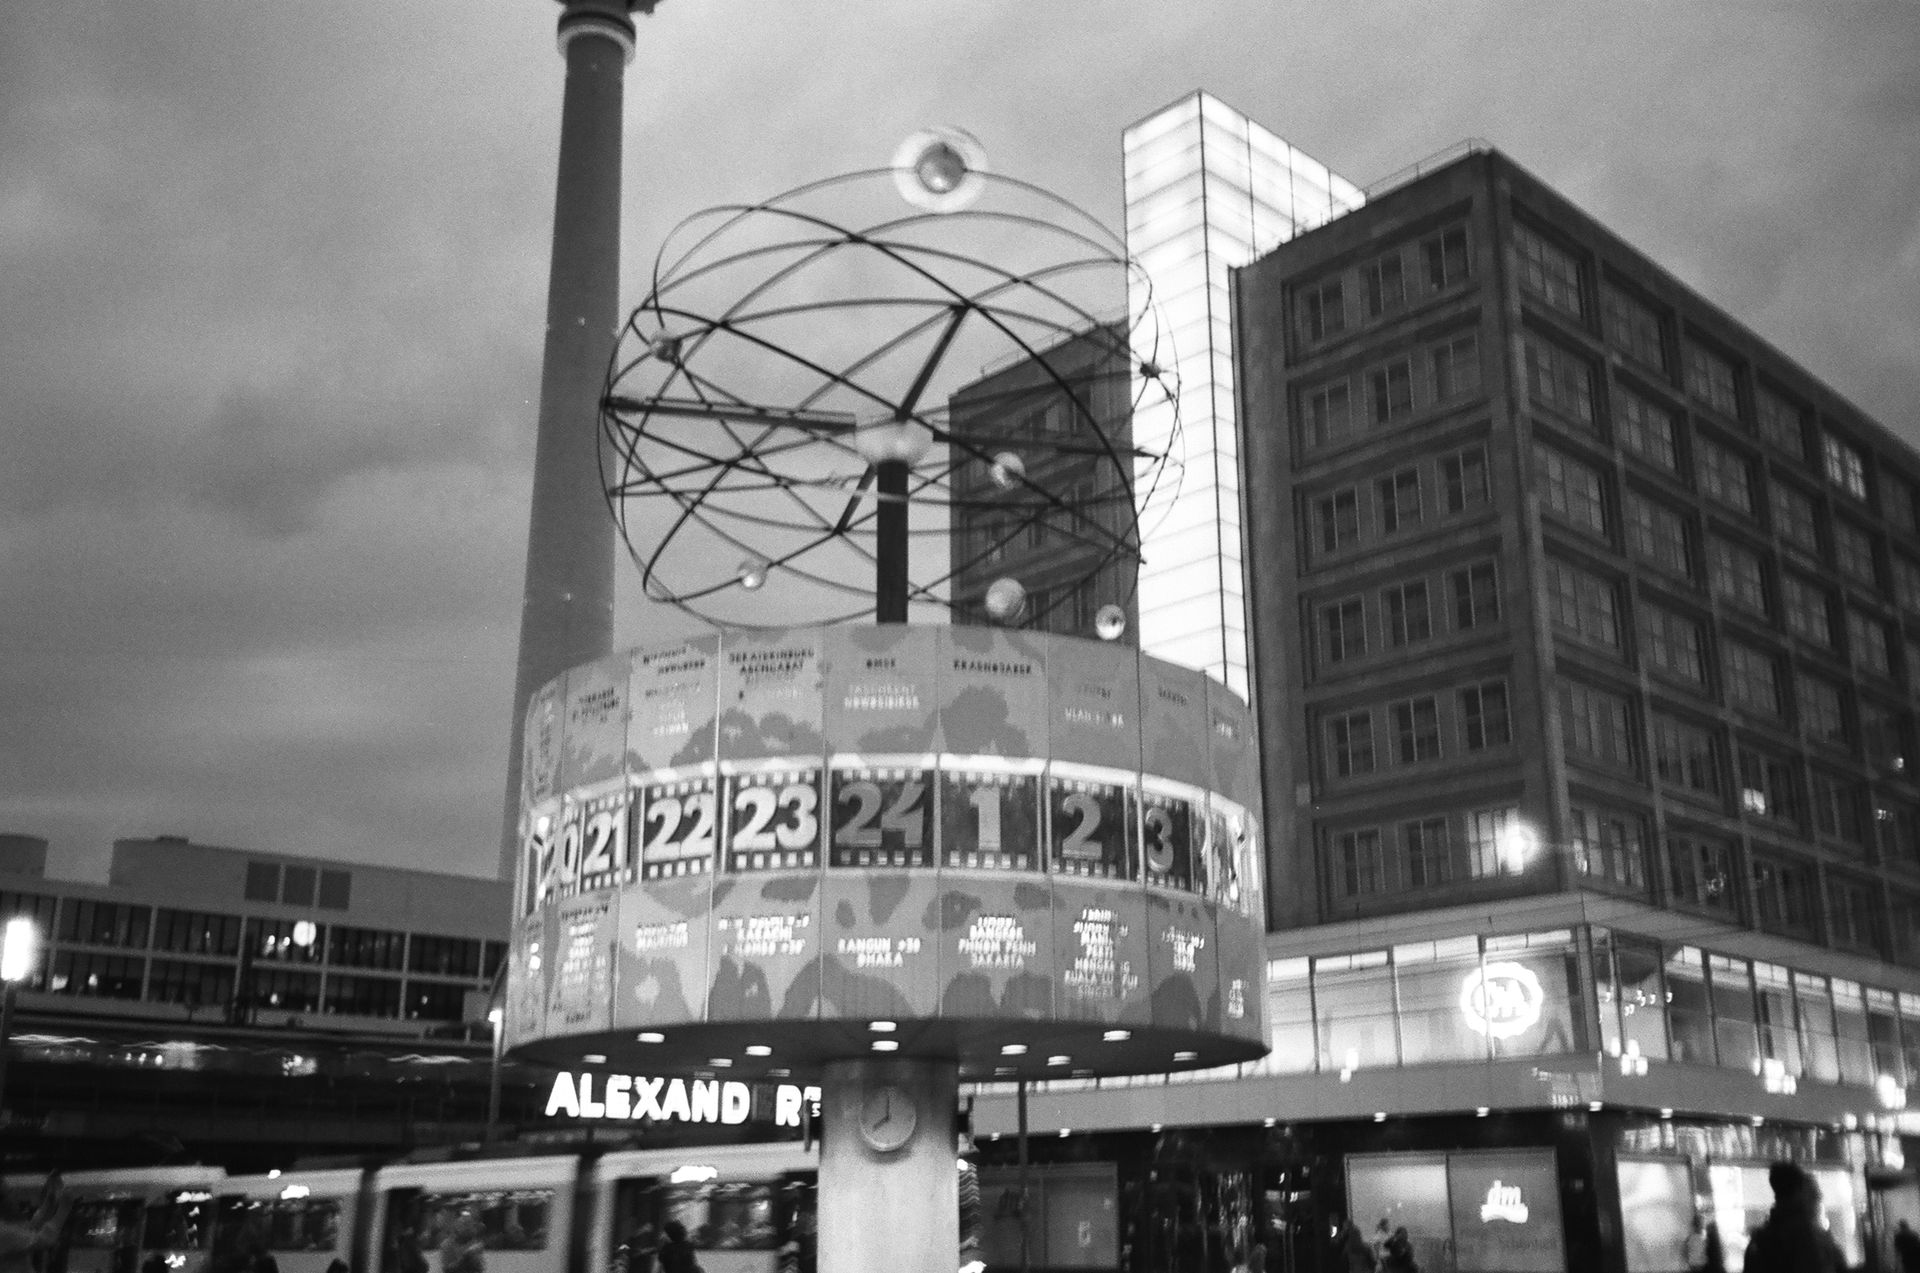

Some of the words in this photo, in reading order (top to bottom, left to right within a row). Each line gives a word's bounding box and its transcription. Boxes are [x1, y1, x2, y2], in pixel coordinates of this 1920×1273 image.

[583, 805, 628, 876] 21
[644, 792, 716, 863] 22
[732, 784, 818, 850] 23
[835, 780, 927, 849] 24
[969, 786, 1001, 851] 1
[1062, 793, 1103, 860] 2
[1145, 805, 1175, 873] 3
